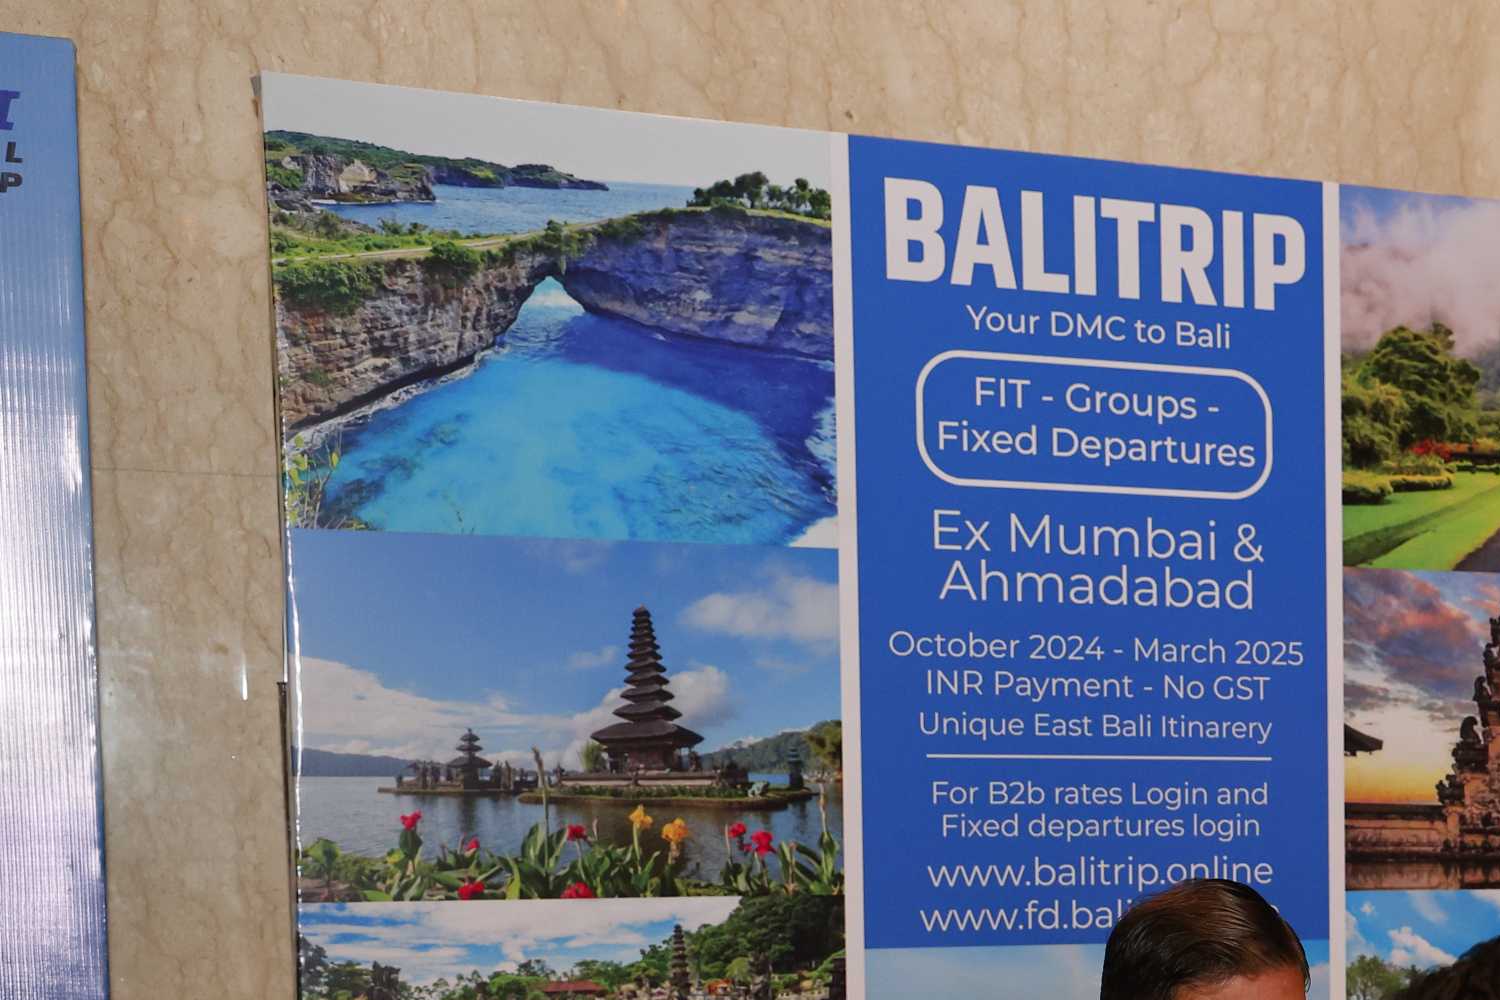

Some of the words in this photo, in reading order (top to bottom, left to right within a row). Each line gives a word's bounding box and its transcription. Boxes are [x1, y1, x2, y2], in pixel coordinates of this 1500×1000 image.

[884, 176, 1306, 311] BALITRIP
[966, 305, 1040, 334] Your
[1050, 311, 1126, 342] DMC
[1134, 320, 1165, 343] to
[1175, 321, 1231, 349] Bali
[975, 376, 1030, 409] FIT
[1065, 383, 1197, 424] Groups
[937, 421, 1037, 455] Fixed
[1052, 426, 1256, 468] Departures
[933, 509, 991, 551] Ex
[1010, 513, 1217, 561] Mumbai
[1233, 524, 1265, 562] &
[939, 559, 1253, 610] Ahmadabad
[889, 631, 1019, 659] October
[1029, 634, 1104, 661] 2024
[1134, 637, 1226, 665] March
[1235, 640, 1304, 666] 2025
[927, 669, 983, 696] INR
[995, 671, 1134, 702] Payment
[1164, 675, 1204, 700] No
[1213, 676, 1270, 701] GST
[919, 712, 1024, 740] Unique
[1035, 714, 1092, 737] East
[1102, 715, 1152, 738] Bali
[1161, 716, 1272, 744] Itinarery
[932, 781, 979, 805] For
[990, 781, 1045, 806] B2b
[1055, 784, 1122, 806] rates
[1132, 782, 1208, 811] Login
[1217, 783, 1268, 805] and
[942, 813, 1019, 837] Fixed
[1028, 813, 1185, 842] departures
[1193, 814, 1260, 842] login
[927, 856, 1274, 892] www.balitrip.online
